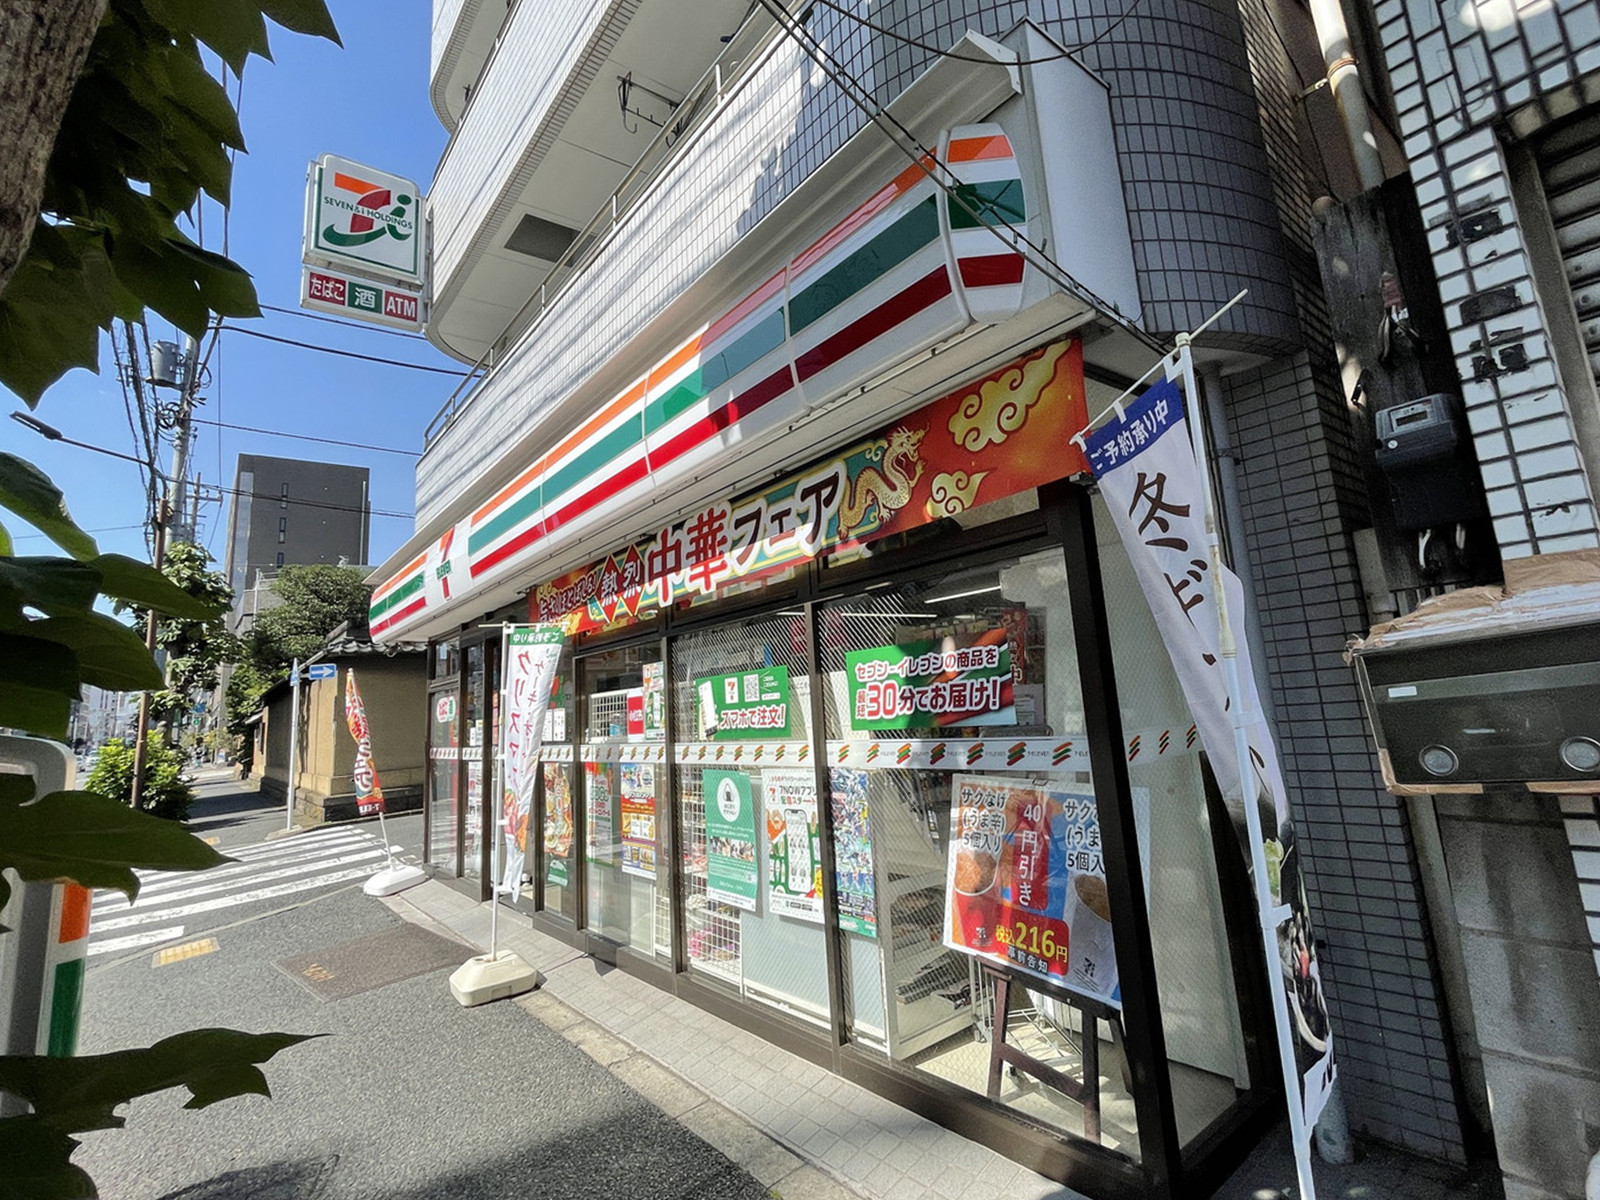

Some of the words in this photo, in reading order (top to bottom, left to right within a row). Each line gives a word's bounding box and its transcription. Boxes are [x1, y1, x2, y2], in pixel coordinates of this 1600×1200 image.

[367, 210, 413, 230] HOLDINGS
[310, 277, 345, 301] たばこ
[355, 287, 377, 308] 酒
[386, 296, 416, 318] ATM
[1089, 398, 1169, 471] ご予約承り中
[601, 558, 643, 607] 熱烈
[647, 470, 841, 603] 中華フェア
[720, 704, 786, 728] スマホで注文!
[962, 809, 1006, 834] (うま辛)
[962, 831, 1002, 853] 5個入り
[995, 922, 1068, 963] 税込216円
